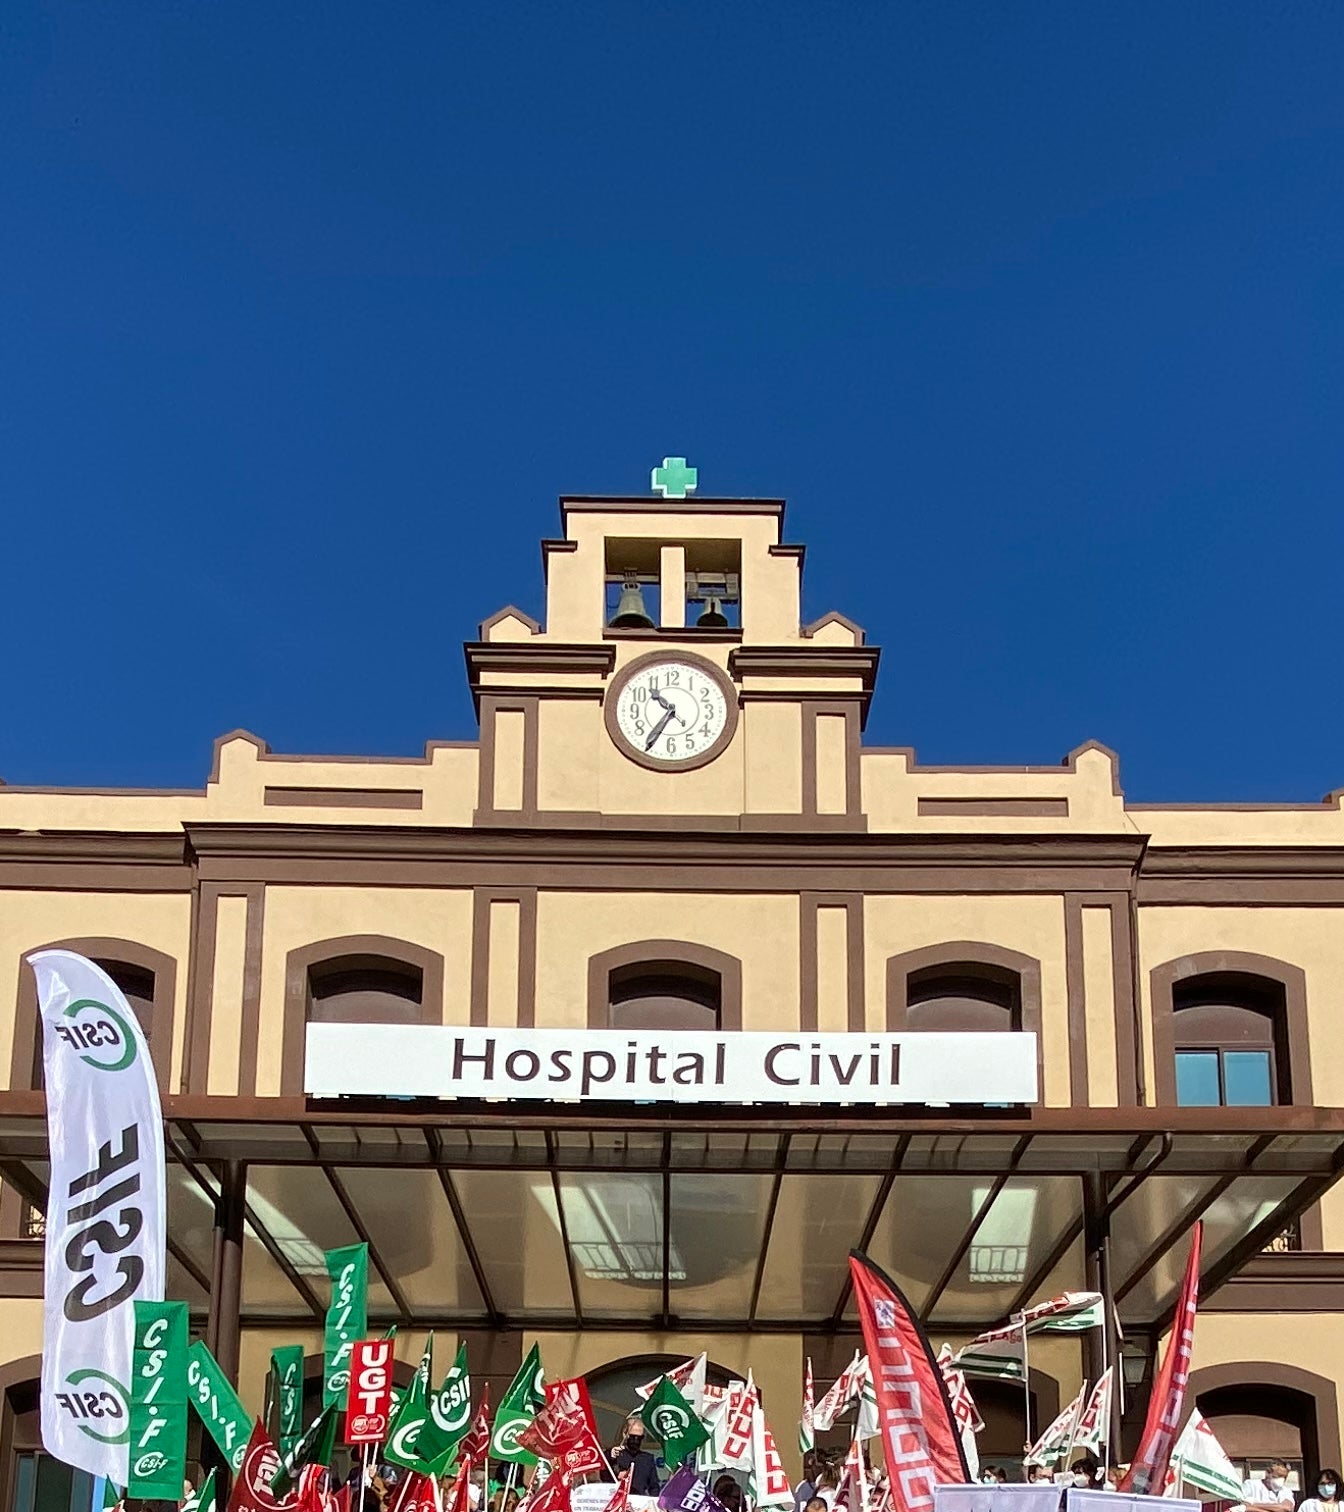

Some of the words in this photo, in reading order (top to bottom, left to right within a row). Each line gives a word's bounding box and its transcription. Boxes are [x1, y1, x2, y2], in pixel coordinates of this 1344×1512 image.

[665, 670, 680, 687] 12
[632, 686, 647, 702] 10
[700, 687, 710, 702] 2
[630, 703, 640, 720] 9
[704, 704, 714, 720] 3
[634, 719, 645, 736] 8
[698, 722, 711, 737] 4
[666, 737, 676, 753] 6
[686, 733, 695, 749] 5
[451, 1037, 725, 1096] Hospital
[763, 1043, 901, 1086] Civil
[358, 1344, 388, 1414] UGT
